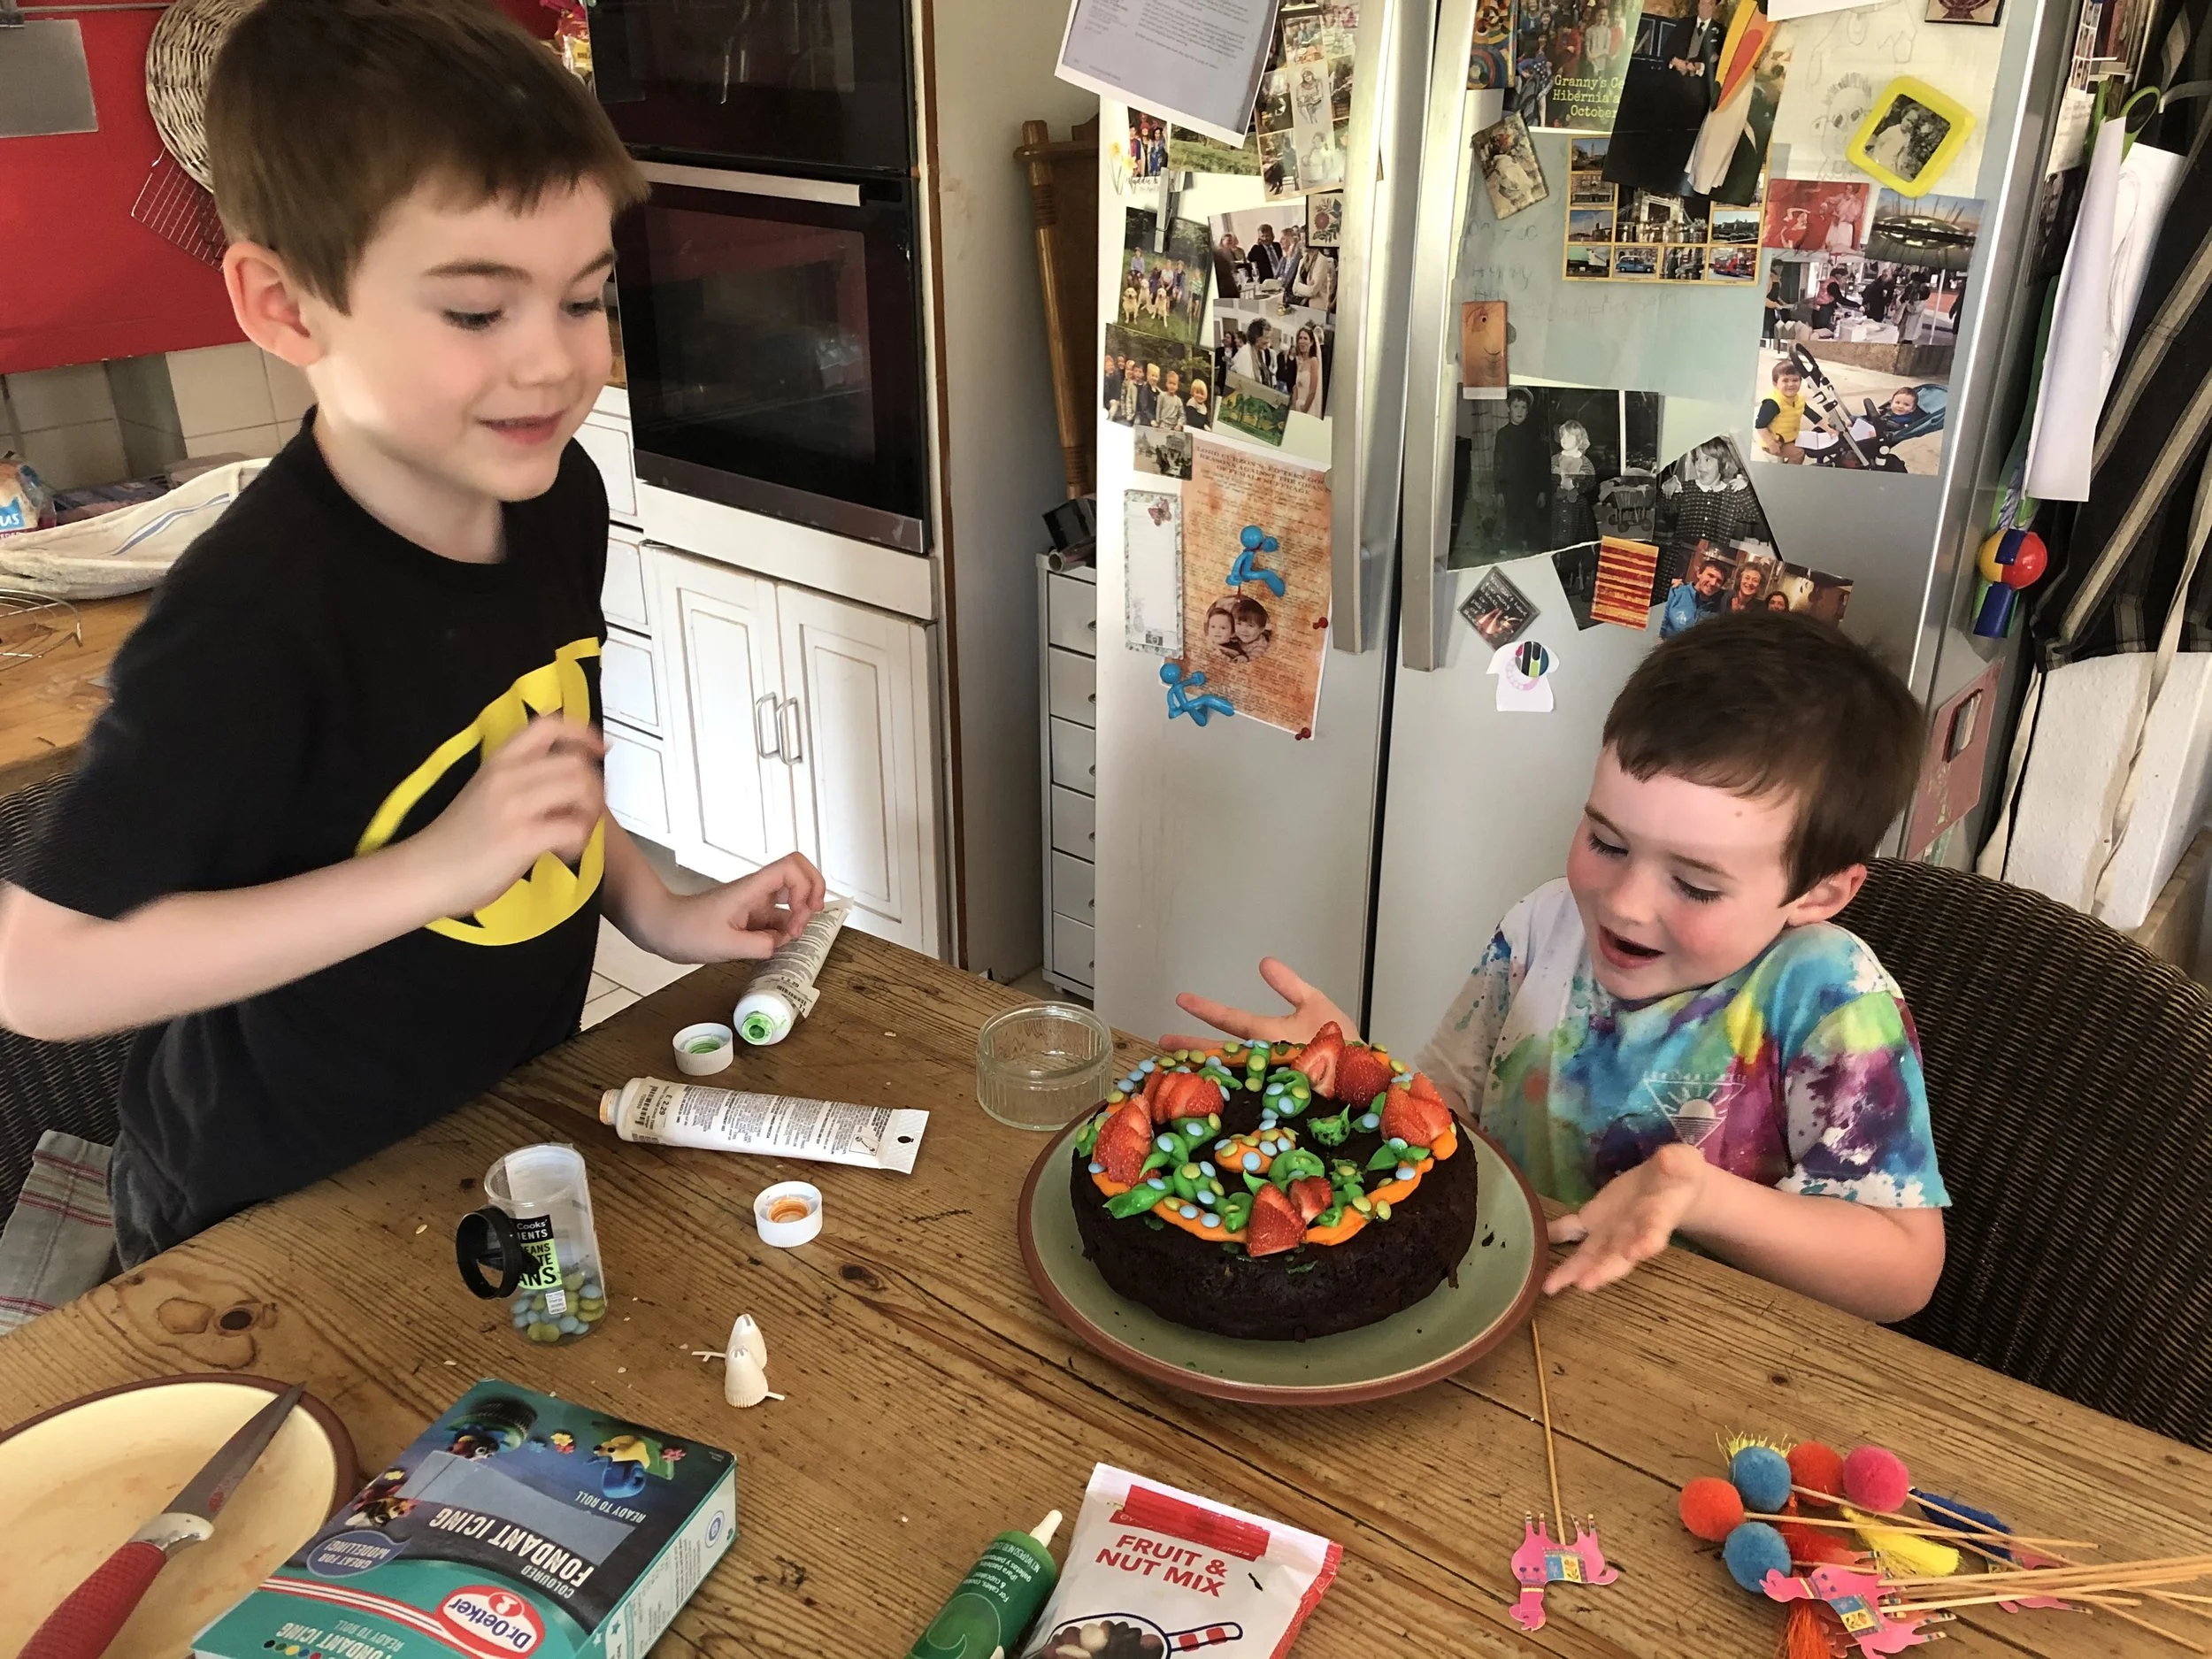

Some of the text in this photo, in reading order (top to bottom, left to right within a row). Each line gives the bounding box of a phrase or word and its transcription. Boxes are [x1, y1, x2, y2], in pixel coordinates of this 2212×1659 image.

[1555, 74, 1608, 90] Granny's
[1553, 88, 1609, 104] Hibernia
[1571, 104, 1617, 119] October
[659, 1101, 670, 1116] 2.29
[576, 1490, 647, 1524] READY TO ROLL
[324, 1540, 391, 1560] MODELLING!
[429, 1508, 595, 1588] FONDANT ICING
[1116, 1534, 1202, 1567] FRUIT
[1204, 1559, 1229, 1578] &
[318, 1553, 373, 1570] GREAT FOR
[1030, 1560, 1041, 1573] NET
[520, 1564, 575, 1599] COLOURED
[1010, 1563, 1033, 1582] galletas
[1095, 1548, 1225, 1598] NUT MIX
[981, 1580, 1000, 1594] cakes,
[999, 1591, 1010, 1603] For
[276, 1622, 324, 1644] ICING
[334, 1619, 405, 1652] READY TO ROLL
